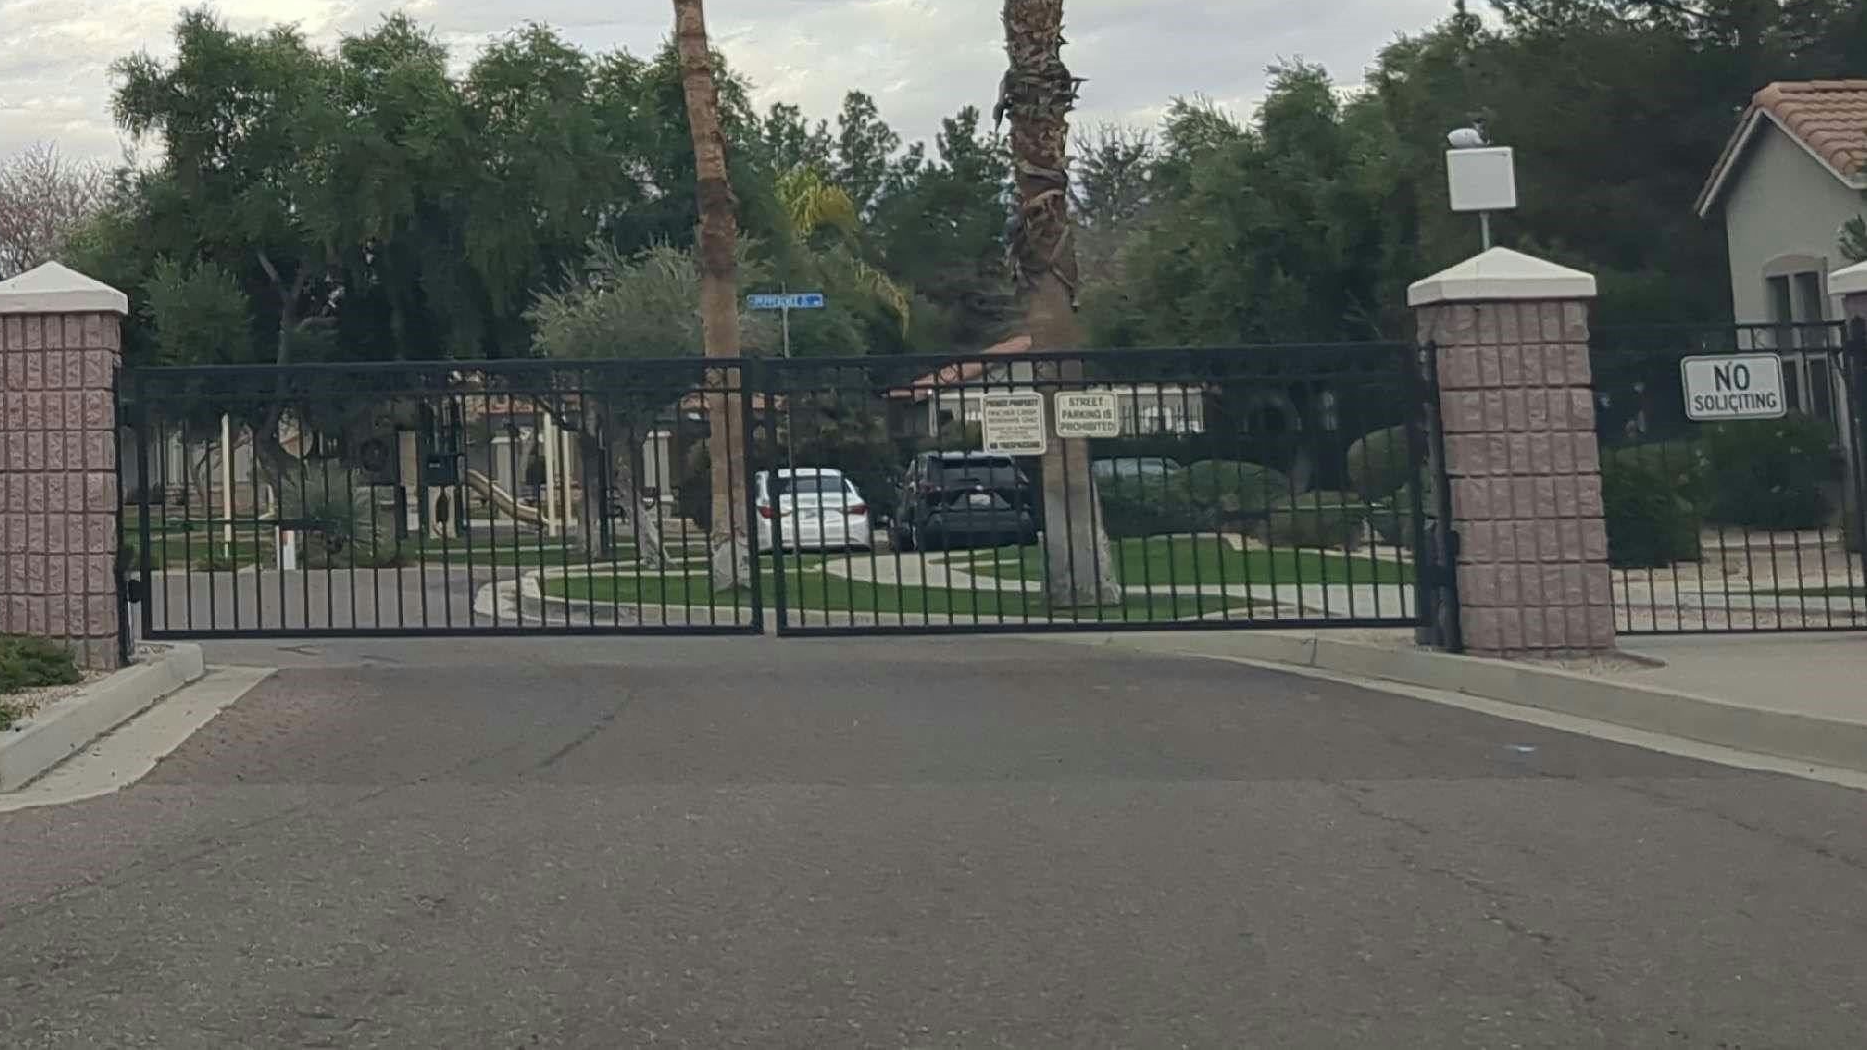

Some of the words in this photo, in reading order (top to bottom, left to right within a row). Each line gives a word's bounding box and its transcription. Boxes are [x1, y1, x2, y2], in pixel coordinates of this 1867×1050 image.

[1713, 363, 1750, 392] NO
[1069, 396, 1103, 406] STREET
[1694, 393, 1777, 411] SOLICITING
[1062, 409, 1101, 419] PARKING
[1103, 409, 1112, 419] IS
[1060, 421, 1115, 431] PROHIBITED
